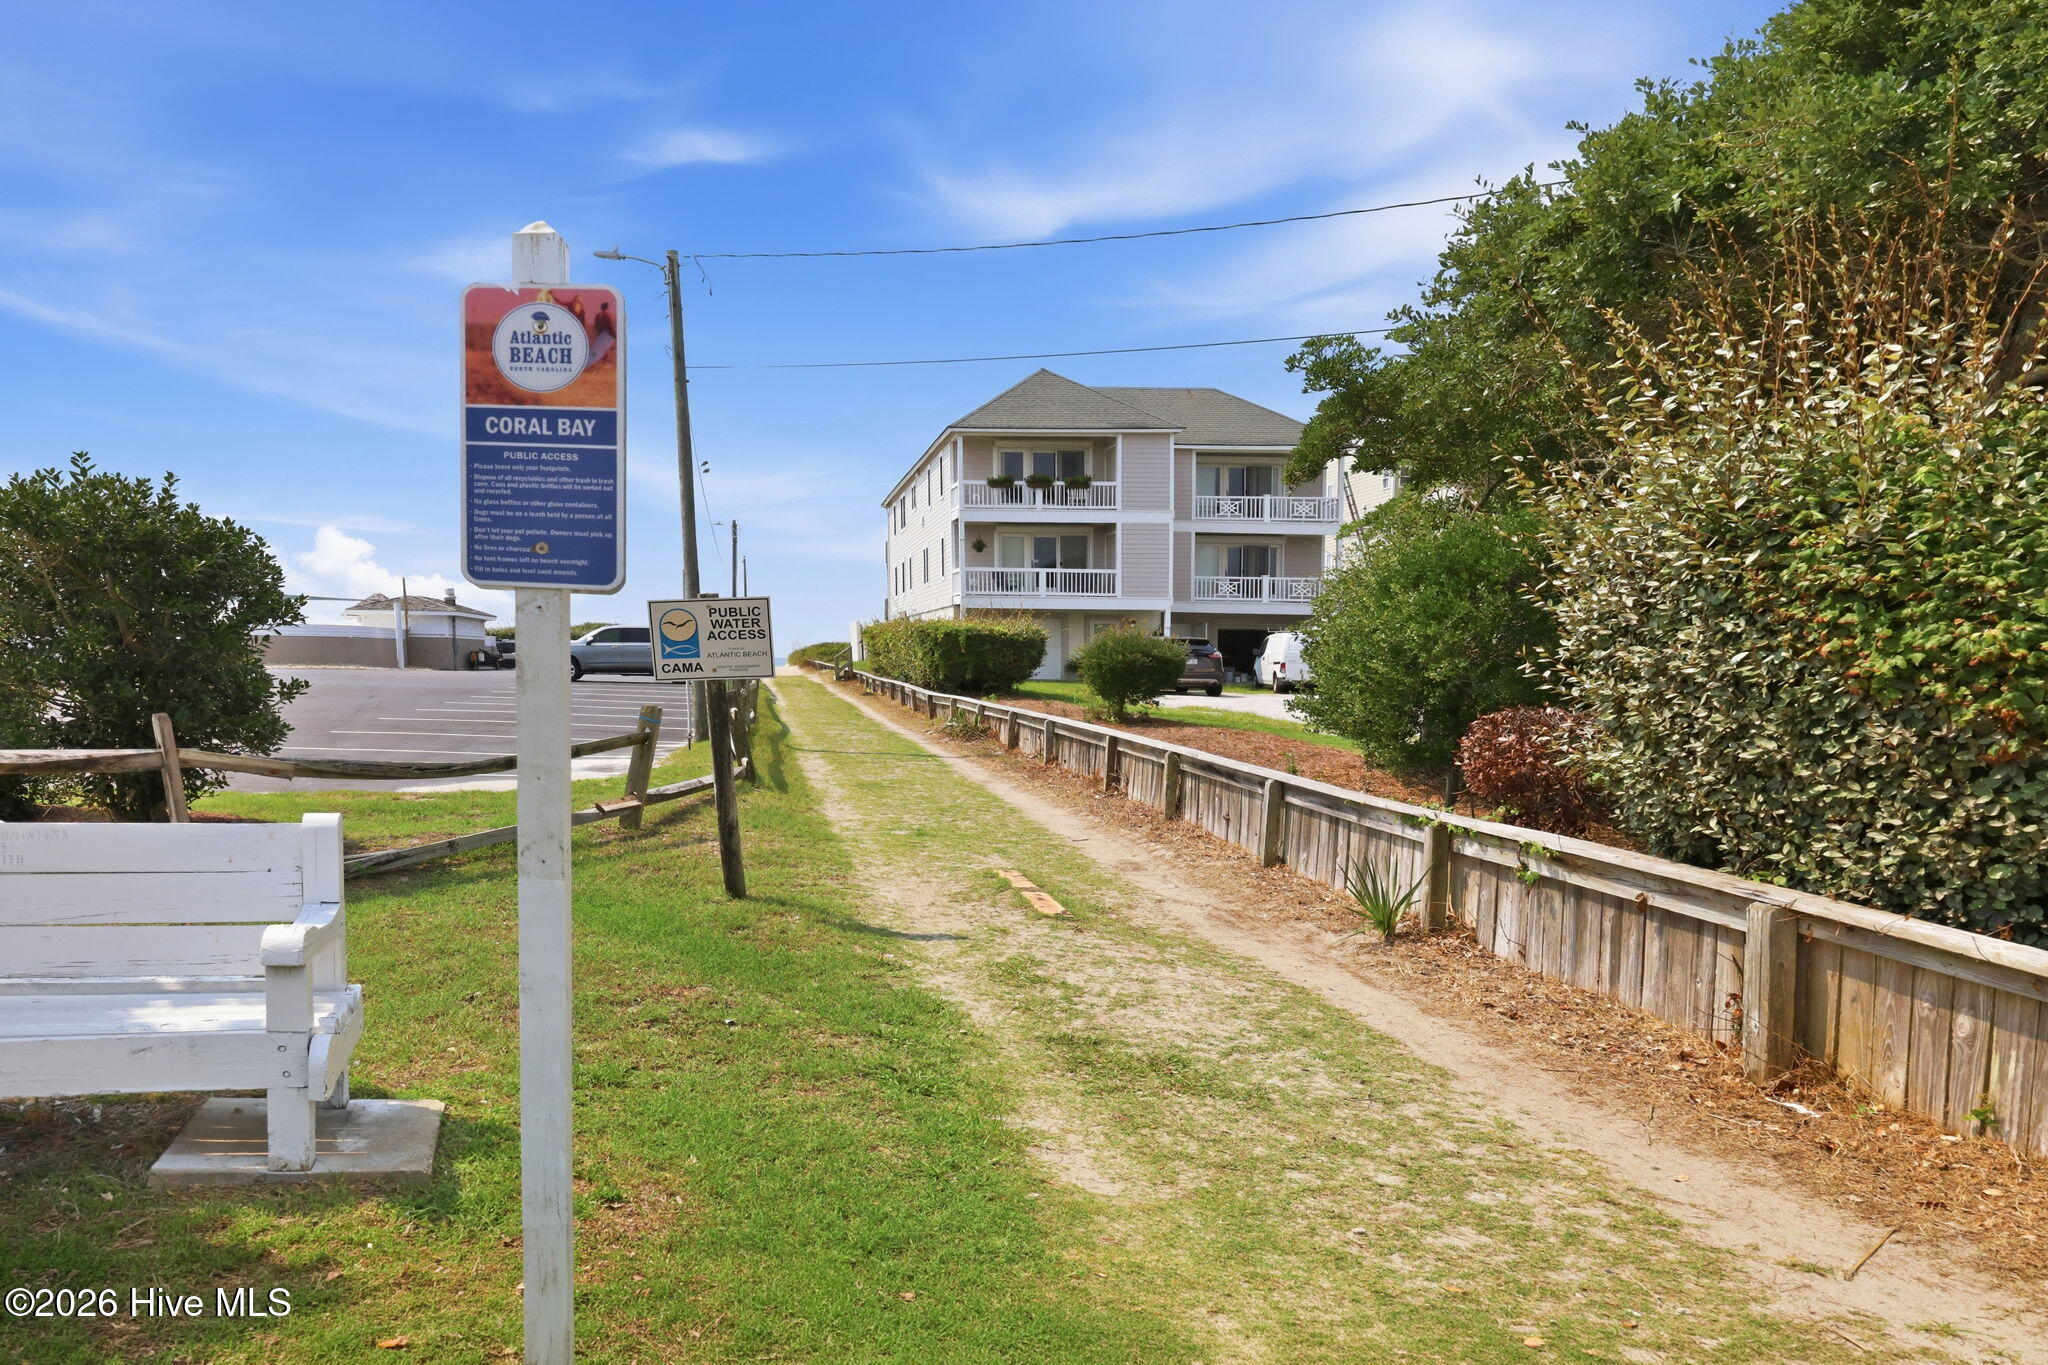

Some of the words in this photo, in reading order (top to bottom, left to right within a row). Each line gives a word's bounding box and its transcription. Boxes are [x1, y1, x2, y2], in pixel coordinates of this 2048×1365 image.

[510, 330, 572, 345] Atlantic
[509, 347, 572, 364] BEACH
[485, 416, 553, 435] CORAL
[558, 418, 596, 437] BAY
[503, 451, 538, 460] PUBLIC
[540, 452, 579, 461] ACCESS
[708, 606, 761, 618] PUBLIC
[710, 618, 761, 629] WATER
[707, 629, 766, 641] ACCESS
[661, 662, 704, 674] CAMA
